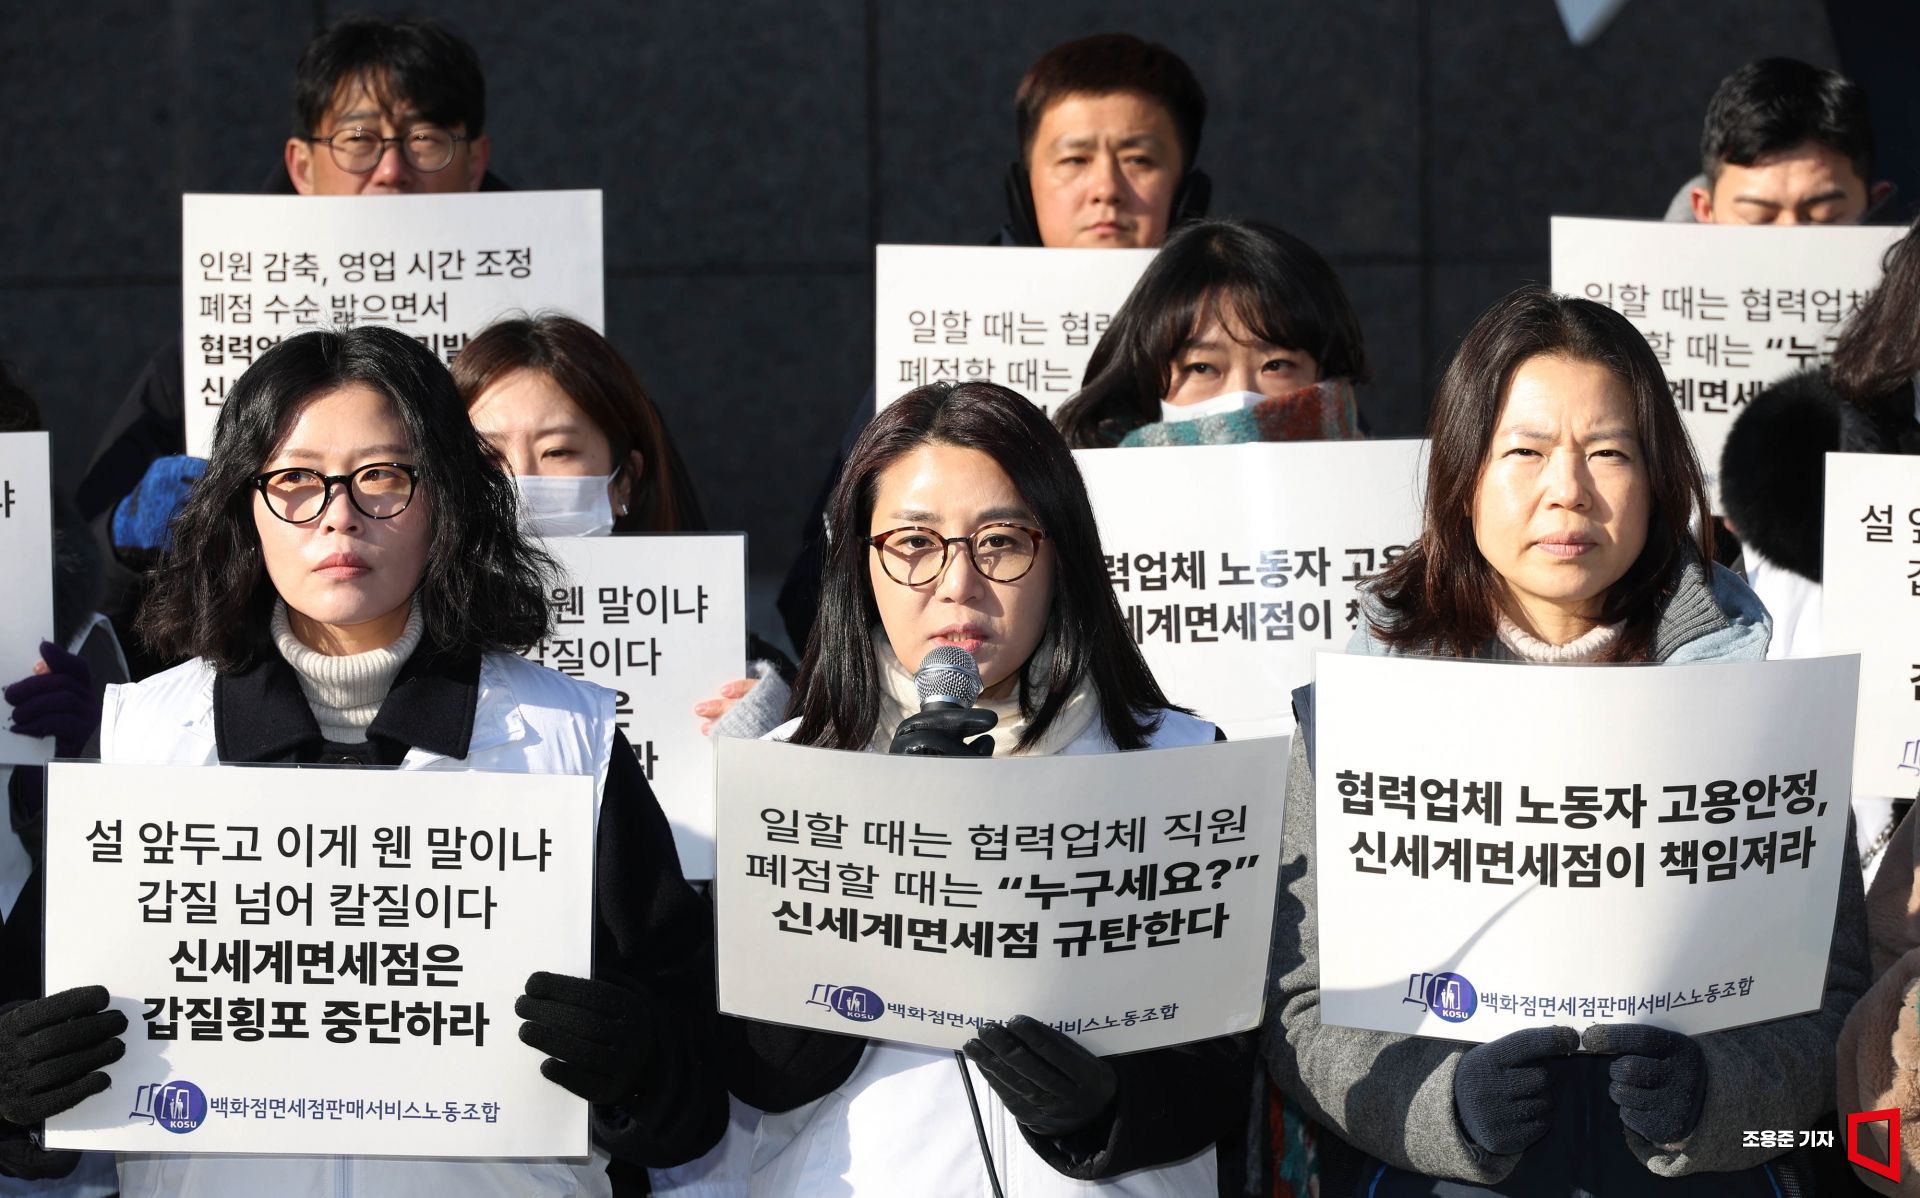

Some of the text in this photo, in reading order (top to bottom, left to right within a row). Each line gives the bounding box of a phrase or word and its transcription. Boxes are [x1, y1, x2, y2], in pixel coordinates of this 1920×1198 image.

[200, 248, 531, 287] 인원 감축, 영업 시간 조정
[200, 292, 447, 323] 폐점 수순 밟으면서
[1663, 286, 1728, 320] 때는
[909, 310, 971, 344] 일할
[984, 311, 1047, 345] 때는
[1687, 334, 1753, 367] 때는
[1008, 359, 1072, 391] 때는
[1861, 505, 1893, 543] 설
[1104, 551, 1205, 592] 력업체
[1218, 547, 1331, 588] 노동자
[550, 585, 708, 625] 웬 말이냐
[1125, 600, 1331, 645] 계면세점이
[1336, 769, 1828, 829] 협력업체 노동자 고용안정,
[86, 820, 552, 872] 설 앞두고 이게 웬 말이냐
[761, 805, 1247, 861] 일할 때는 협력업체 직원
[1349, 826, 1816, 888] 신세계면세점이 책임져라
[746, 854, 1259, 910] 폐점할 때는 “누구세요?”
[138, 880, 497, 929] 갑질 넘어 칼질이다
[772, 901, 1230, 958] 신세계면세점 규탄한다
[169, 939, 463, 987] 신세계면세점은
[847, 1011, 874, 1020] KOSU
[1442, 1009, 1468, 1019] KOSU
[1480, 976, 1755, 1018] 백화점면세점판매서비스노동조합
[142, 996, 490, 1047] 갑질횡포 중단하라
[170, 1120, 197, 1129] KOSU
[210, 1096, 501, 1124] 백화점면세점판매서비스노동조합
